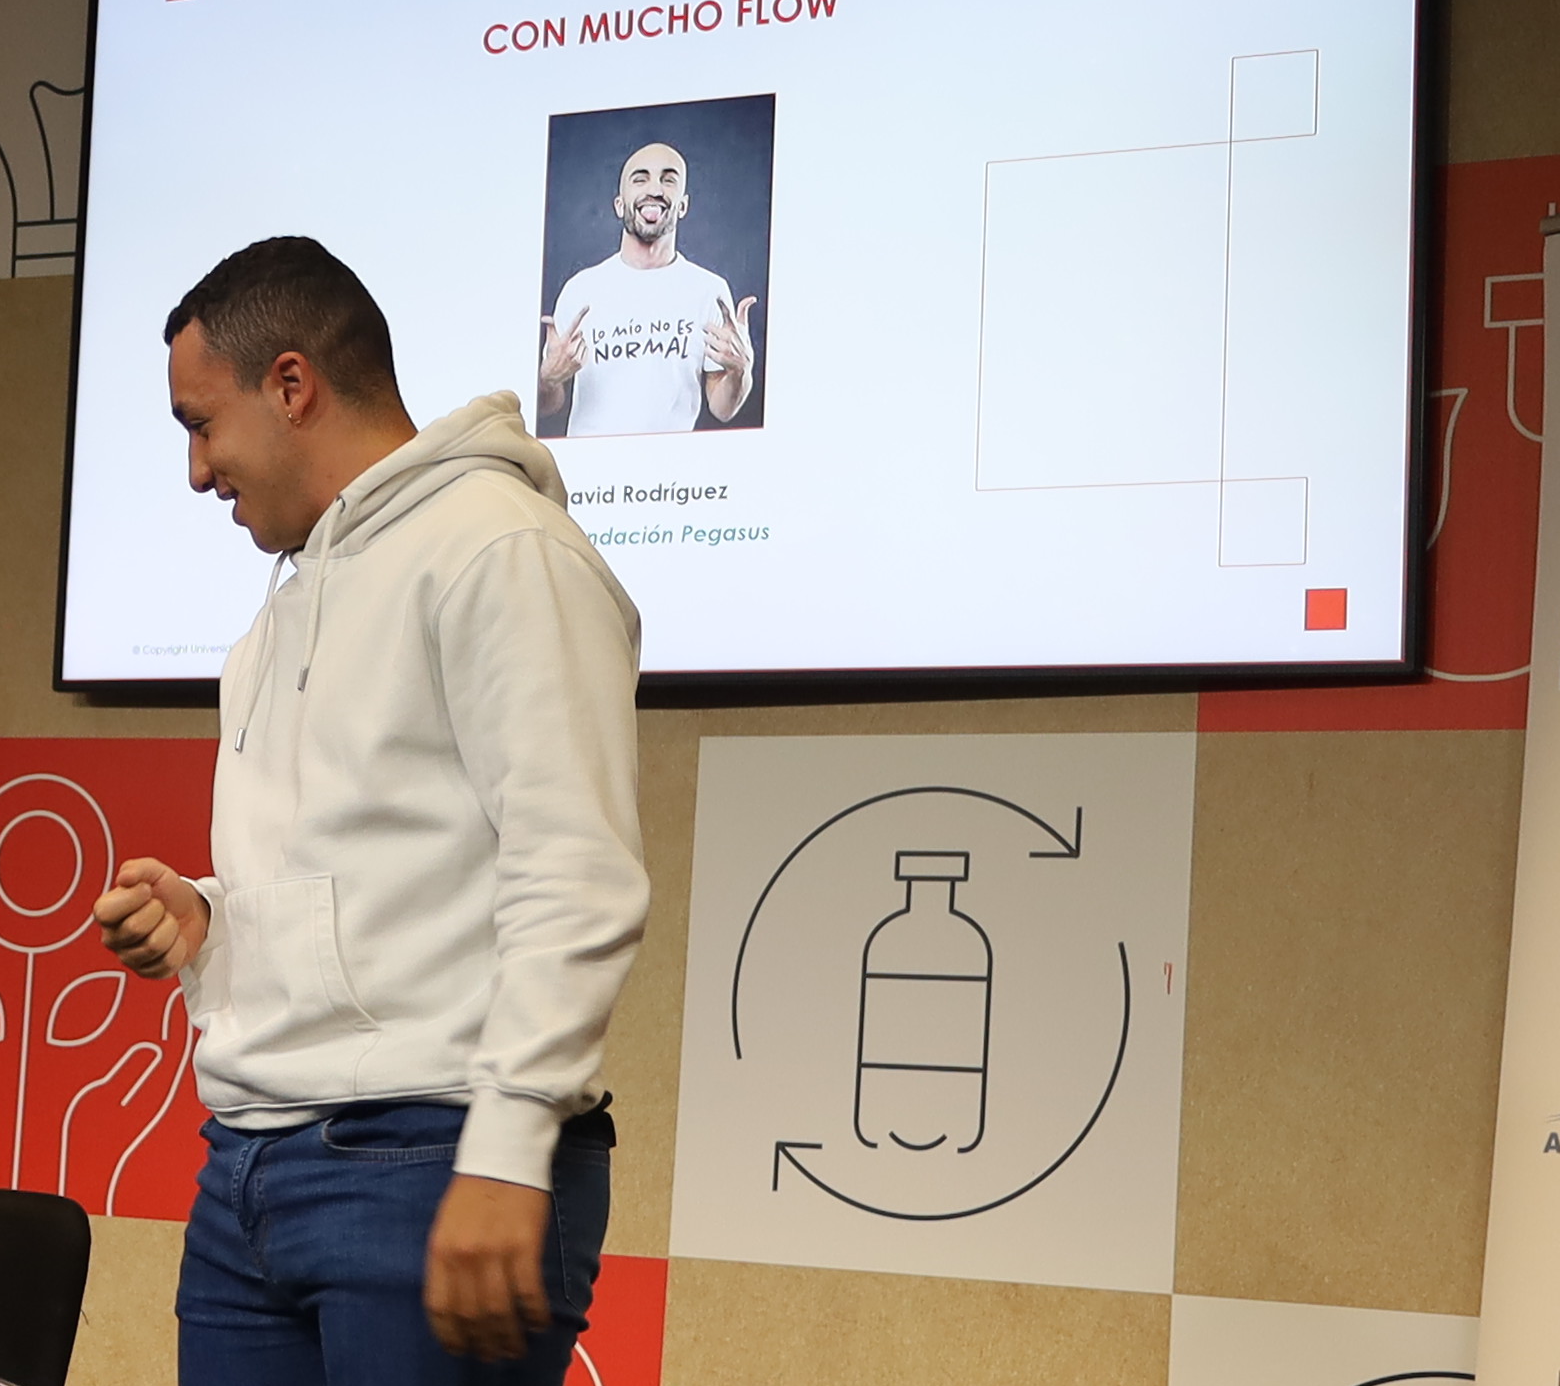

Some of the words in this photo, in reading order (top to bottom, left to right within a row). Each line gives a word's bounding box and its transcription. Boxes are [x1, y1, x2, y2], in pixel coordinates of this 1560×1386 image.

[483, 17, 566, 55] CON
[579, 0, 723, 44] MUCHO
[650, 320, 670, 333] NO
[677, 319, 694, 335] ES
[595, 335, 688, 364] NORMAL
[568, 485, 615, 506] avid
[623, 481, 728, 506] Rodríguez
[587, 524, 673, 546] ndación
[681, 524, 770, 547] Pegasus
